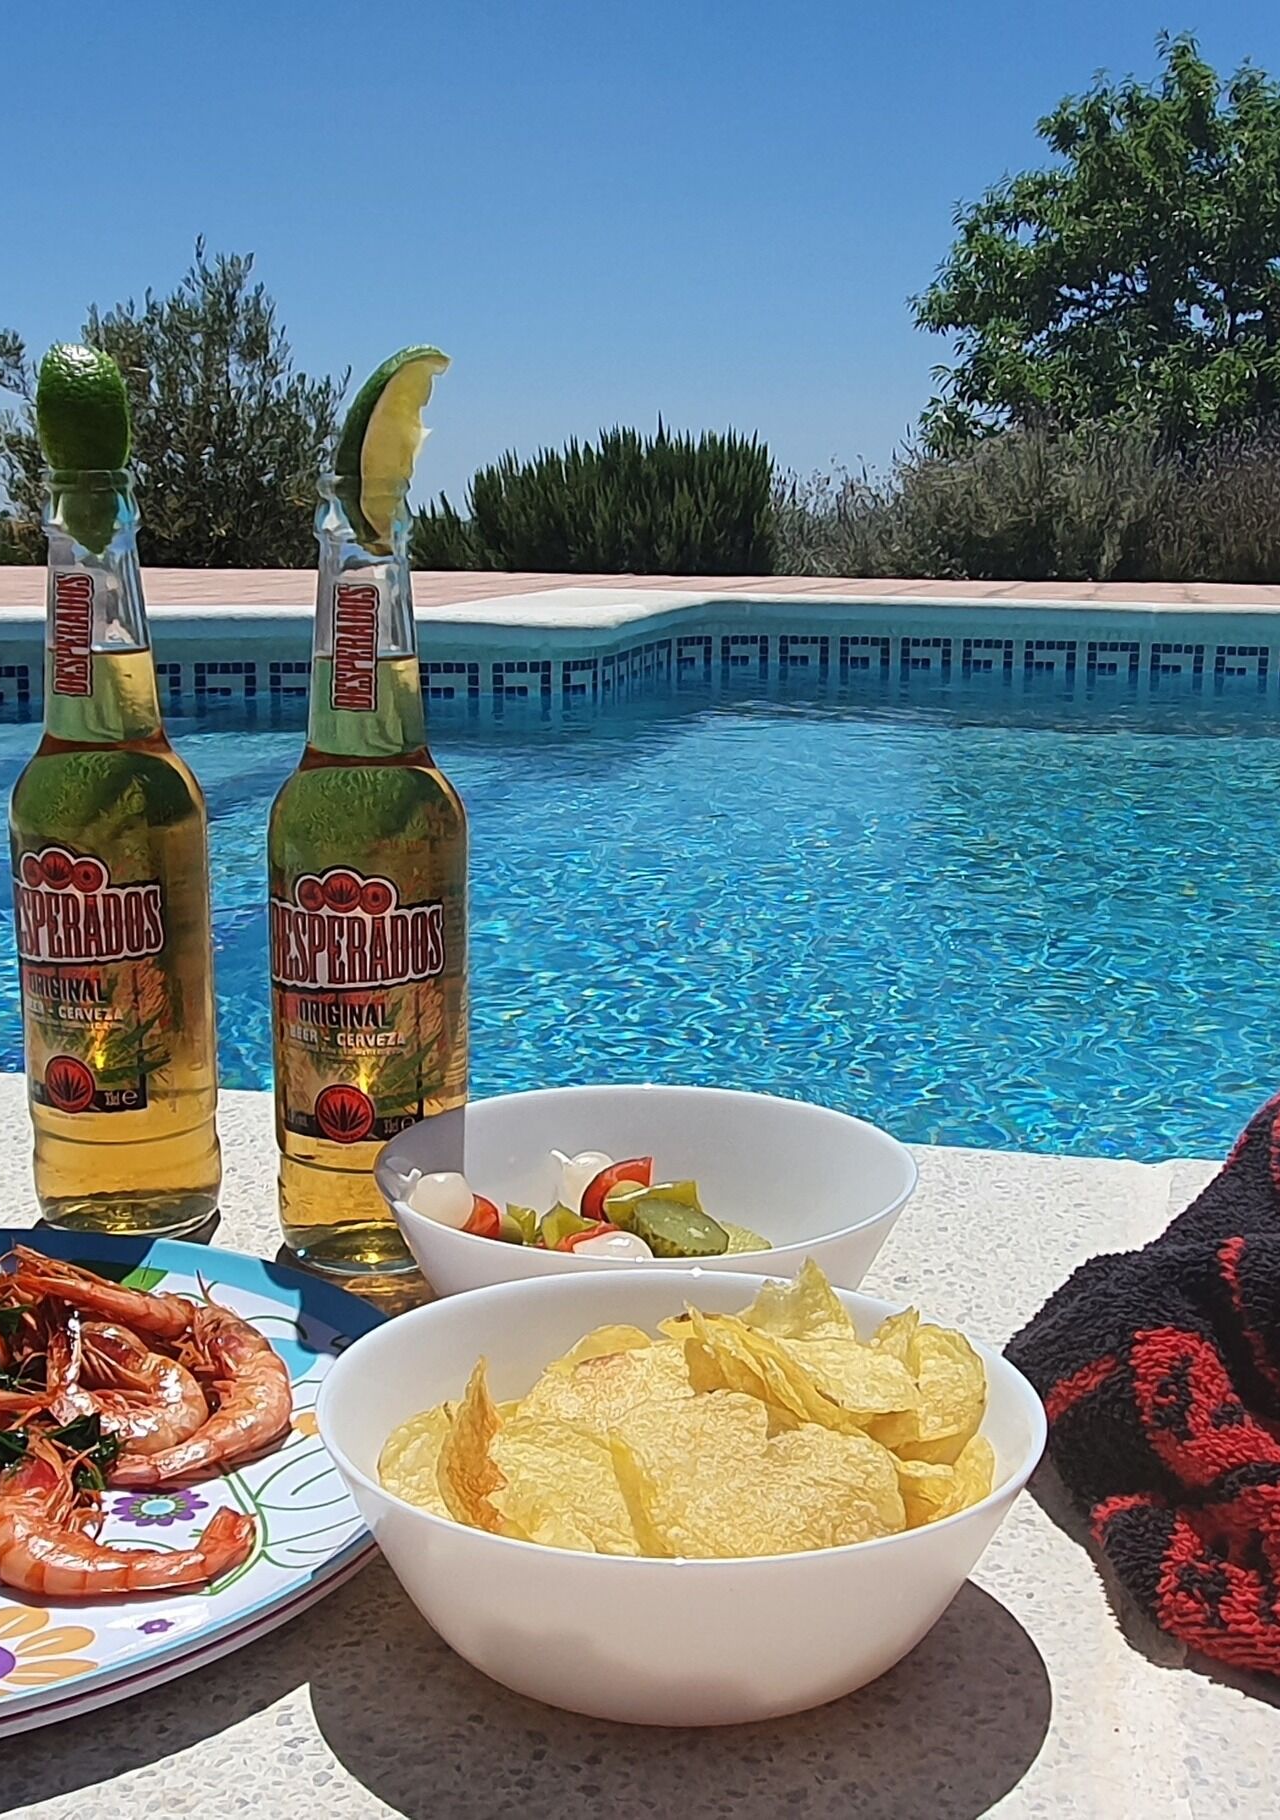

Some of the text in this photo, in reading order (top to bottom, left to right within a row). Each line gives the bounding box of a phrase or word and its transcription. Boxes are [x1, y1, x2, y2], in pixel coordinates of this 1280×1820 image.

[54, 573, 91, 694] DESPERADOS
[334, 585, 376, 709] DESPERADOS
[14, 883, 161, 958] SPERADOS
[271, 903, 441, 985] DESPERADOS
[57, 1005, 124, 1022] CERVEZA
[299, 998, 390, 1030] ORIGINAL
[336, 1031, 406, 1047] CERVEZA
